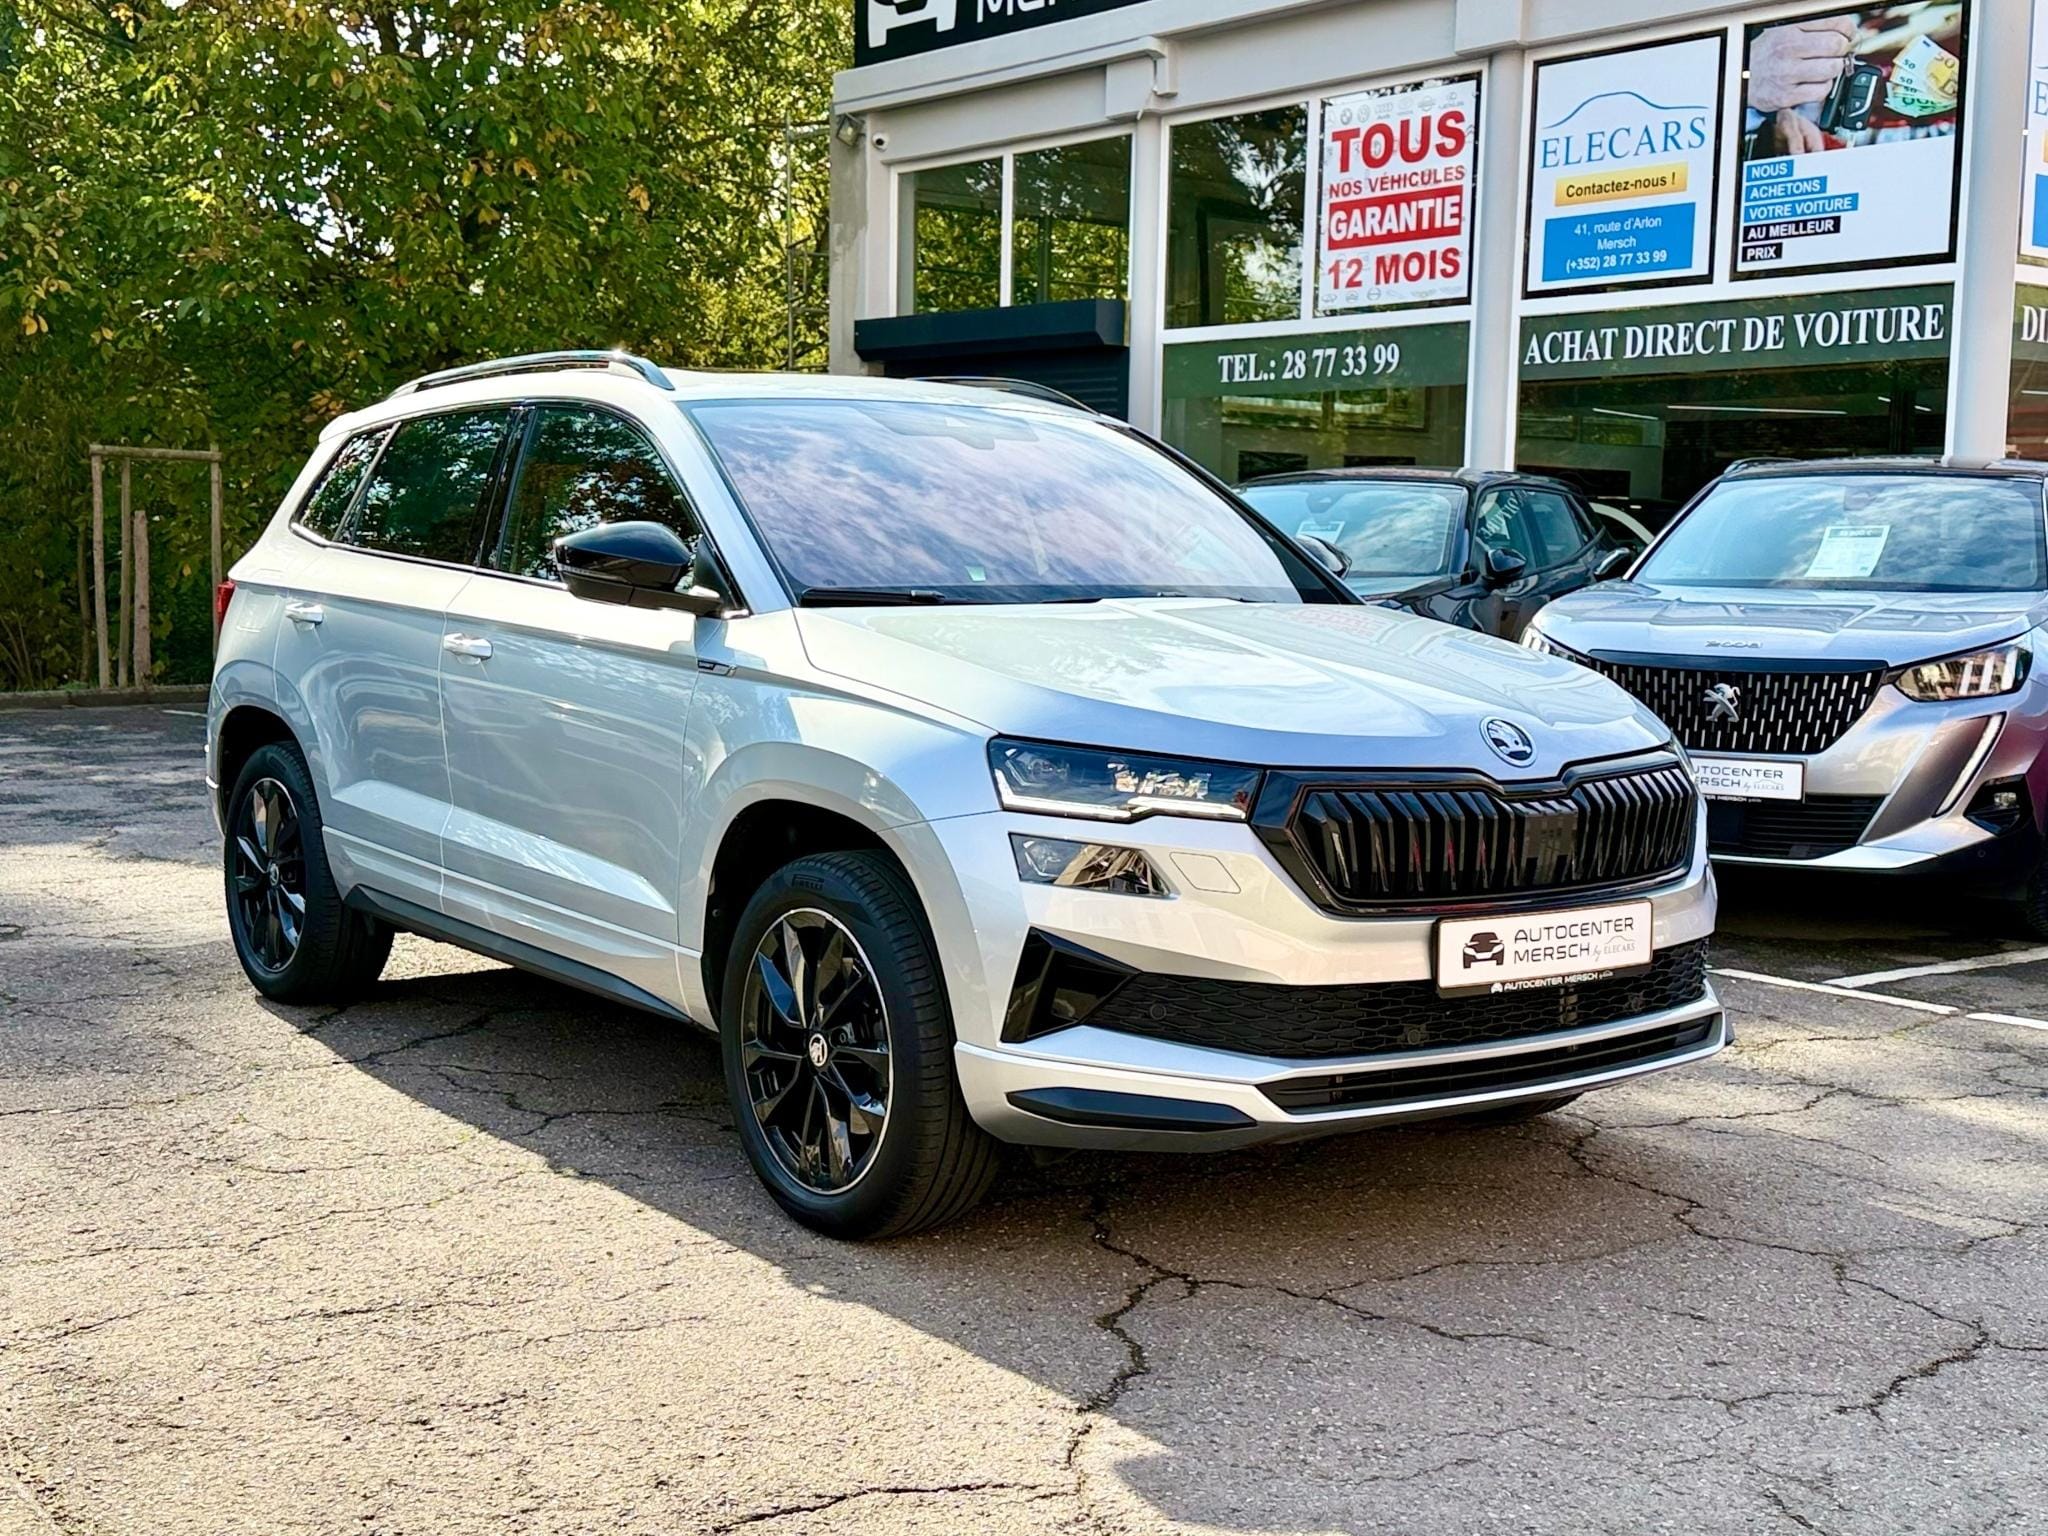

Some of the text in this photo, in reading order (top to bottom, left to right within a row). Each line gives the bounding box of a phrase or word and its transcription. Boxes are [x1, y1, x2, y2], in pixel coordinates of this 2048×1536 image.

[1332, 110, 1466, 173] TOUS
[1540, 117, 1706, 169] ELECARS
[1329, 165, 1466, 199] NOS VÉHICULES
[1751, 163, 1788, 179] NOUS
[1566, 174, 1667, 198] Contactez-nous
[1750, 180, 1821, 199] ACHETONS
[1330, 195, 1461, 241] GARANTIE
[1749, 197, 1852, 220] VOTRE VOITURE
[1574, 216, 1662, 236] 41, route d'Arlon
[1747, 219, 1835, 240] AU MEILLEUR
[1597, 236, 1637, 250] Mersch
[1747, 246, 1777, 260] PRIX
[1328, 247, 1460, 289] 12 MOIS
[1566, 249, 1667, 273] (+352) 28 77 33 99
[1523, 304, 1944, 365] ACHAT DIRECT DE VOITURE
[1218, 343, 1400, 383] TEL.: 28 77 33 99
[1695, 765, 1784, 779] UTOCENTER
[1514, 917, 1634, 944] AUTOCENTER
[1514, 942, 1590, 964] MERSCH
[1603, 942, 1636, 954] ELECARS
[1504, 976, 1563, 990] AUTOCENTER
[1565, 972, 1598, 983] MERSCH
